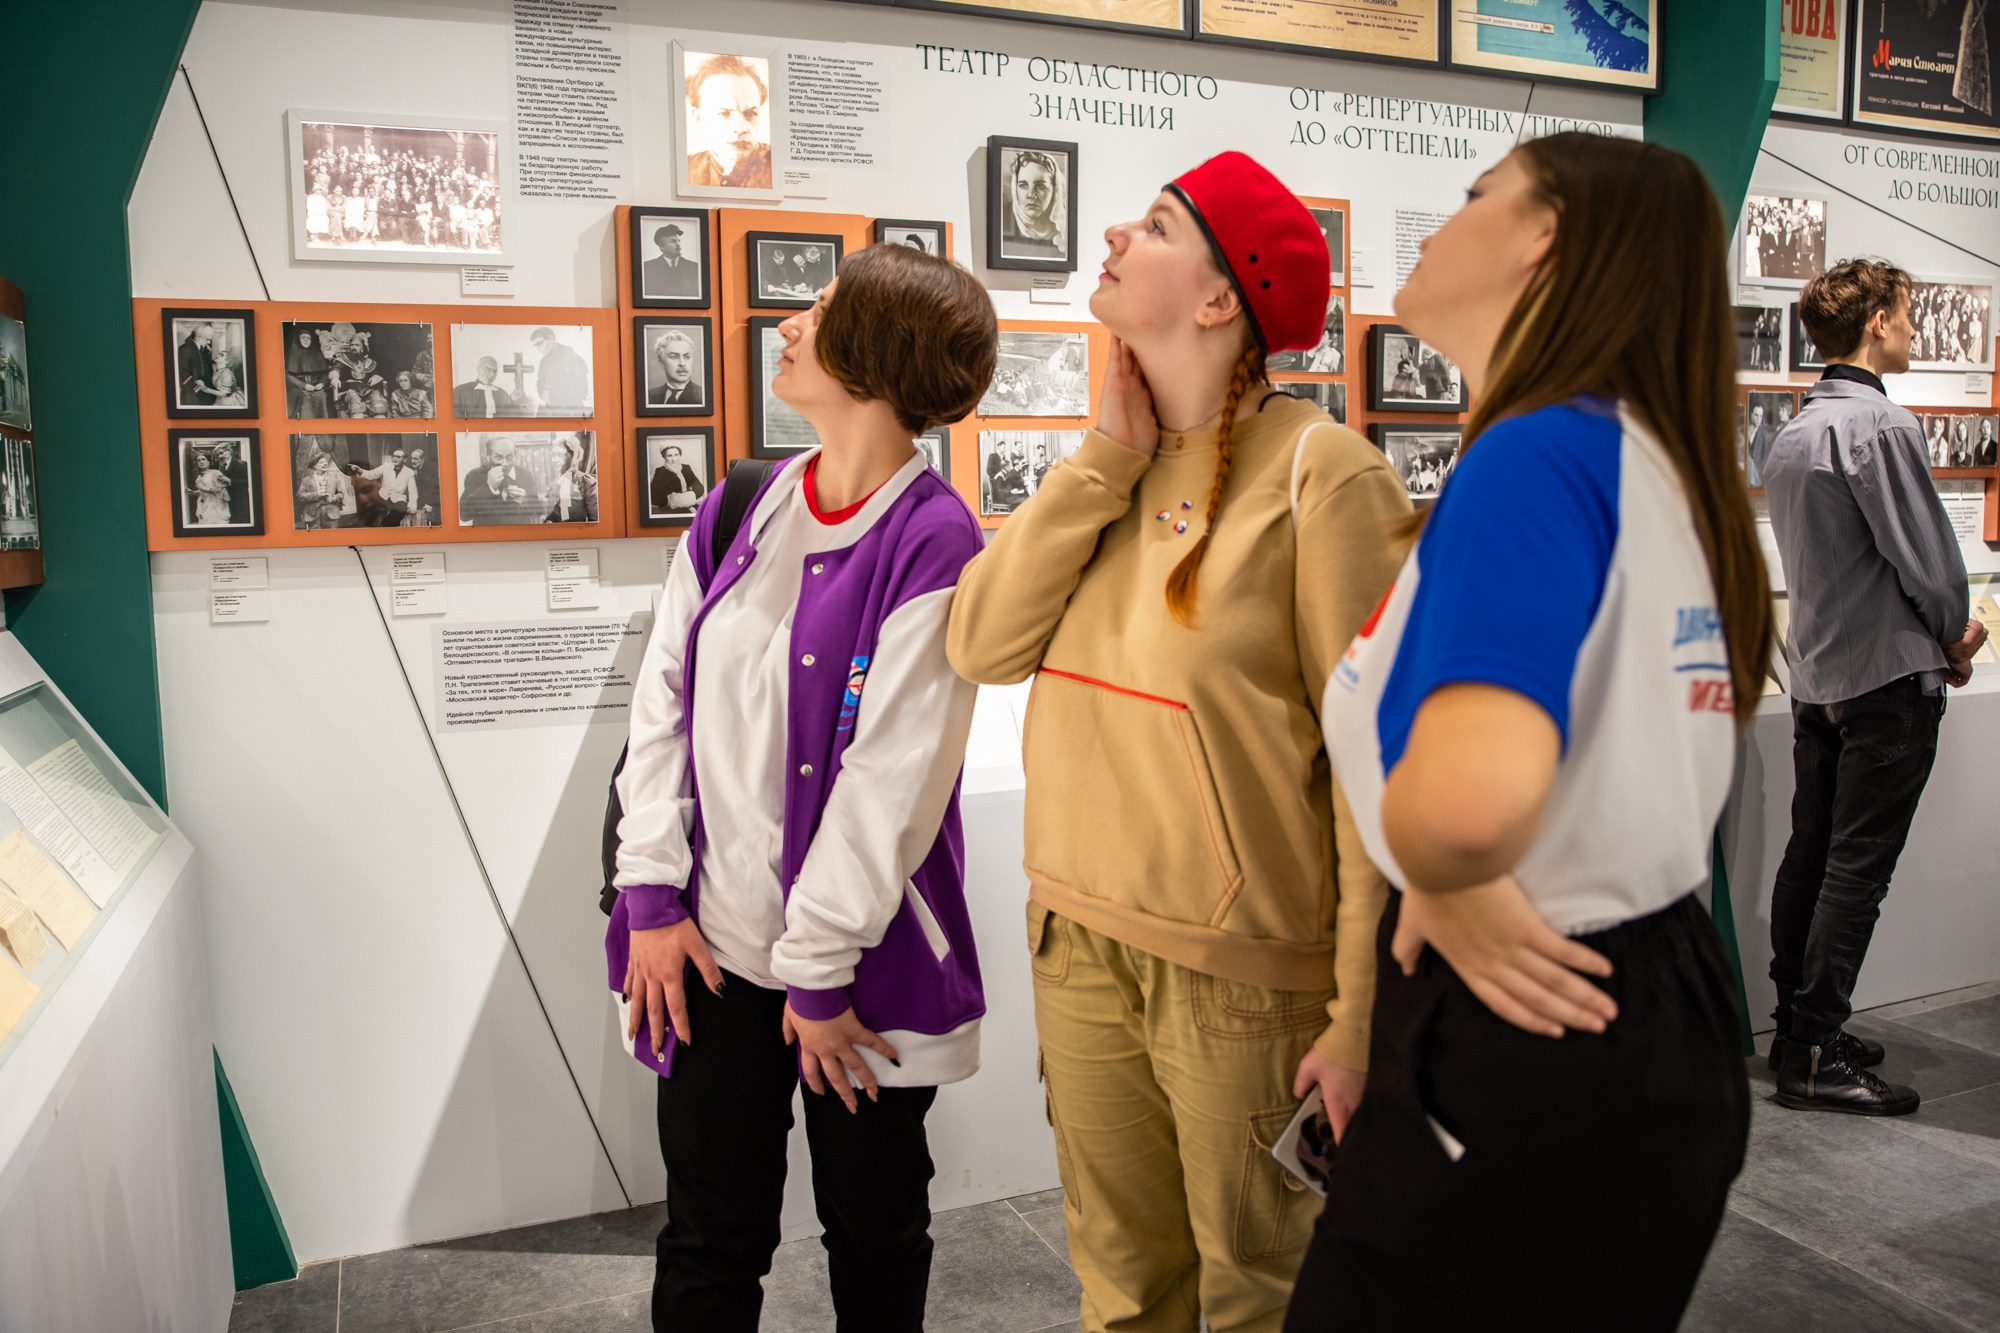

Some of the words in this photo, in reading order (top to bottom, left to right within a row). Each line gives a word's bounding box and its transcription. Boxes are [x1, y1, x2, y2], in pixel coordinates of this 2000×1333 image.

[916, 44, 1010, 77] ТЕАТР
[1028, 56, 1218, 101] ОБЛАСТНОГО
[1872, 39, 1912, 71] Мария
[1914, 56, 1955, 74] Стюарт
[516, 75, 564, 83] Постановление
[1029, 92, 1174, 131] ЗНАЧЕНИЯ
[1290, 87, 1326, 112] ОТ
[1333, 92, 1514, 134] «РЕПЕРТУАРНЫХ
[1290, 121, 1326, 146] ДО
[1333, 125, 1477, 161] «ОТТЕПЕЛИ»
[1844, 144, 1869, 165] ОТ
[1874, 147, 1999, 179] СОВРЕМЕННОЙ
[1888, 179, 1913, 200] ДО
[1918, 182, 1998, 208] БОЛЬШОЙ
[467, 672, 518, 680] художественный
